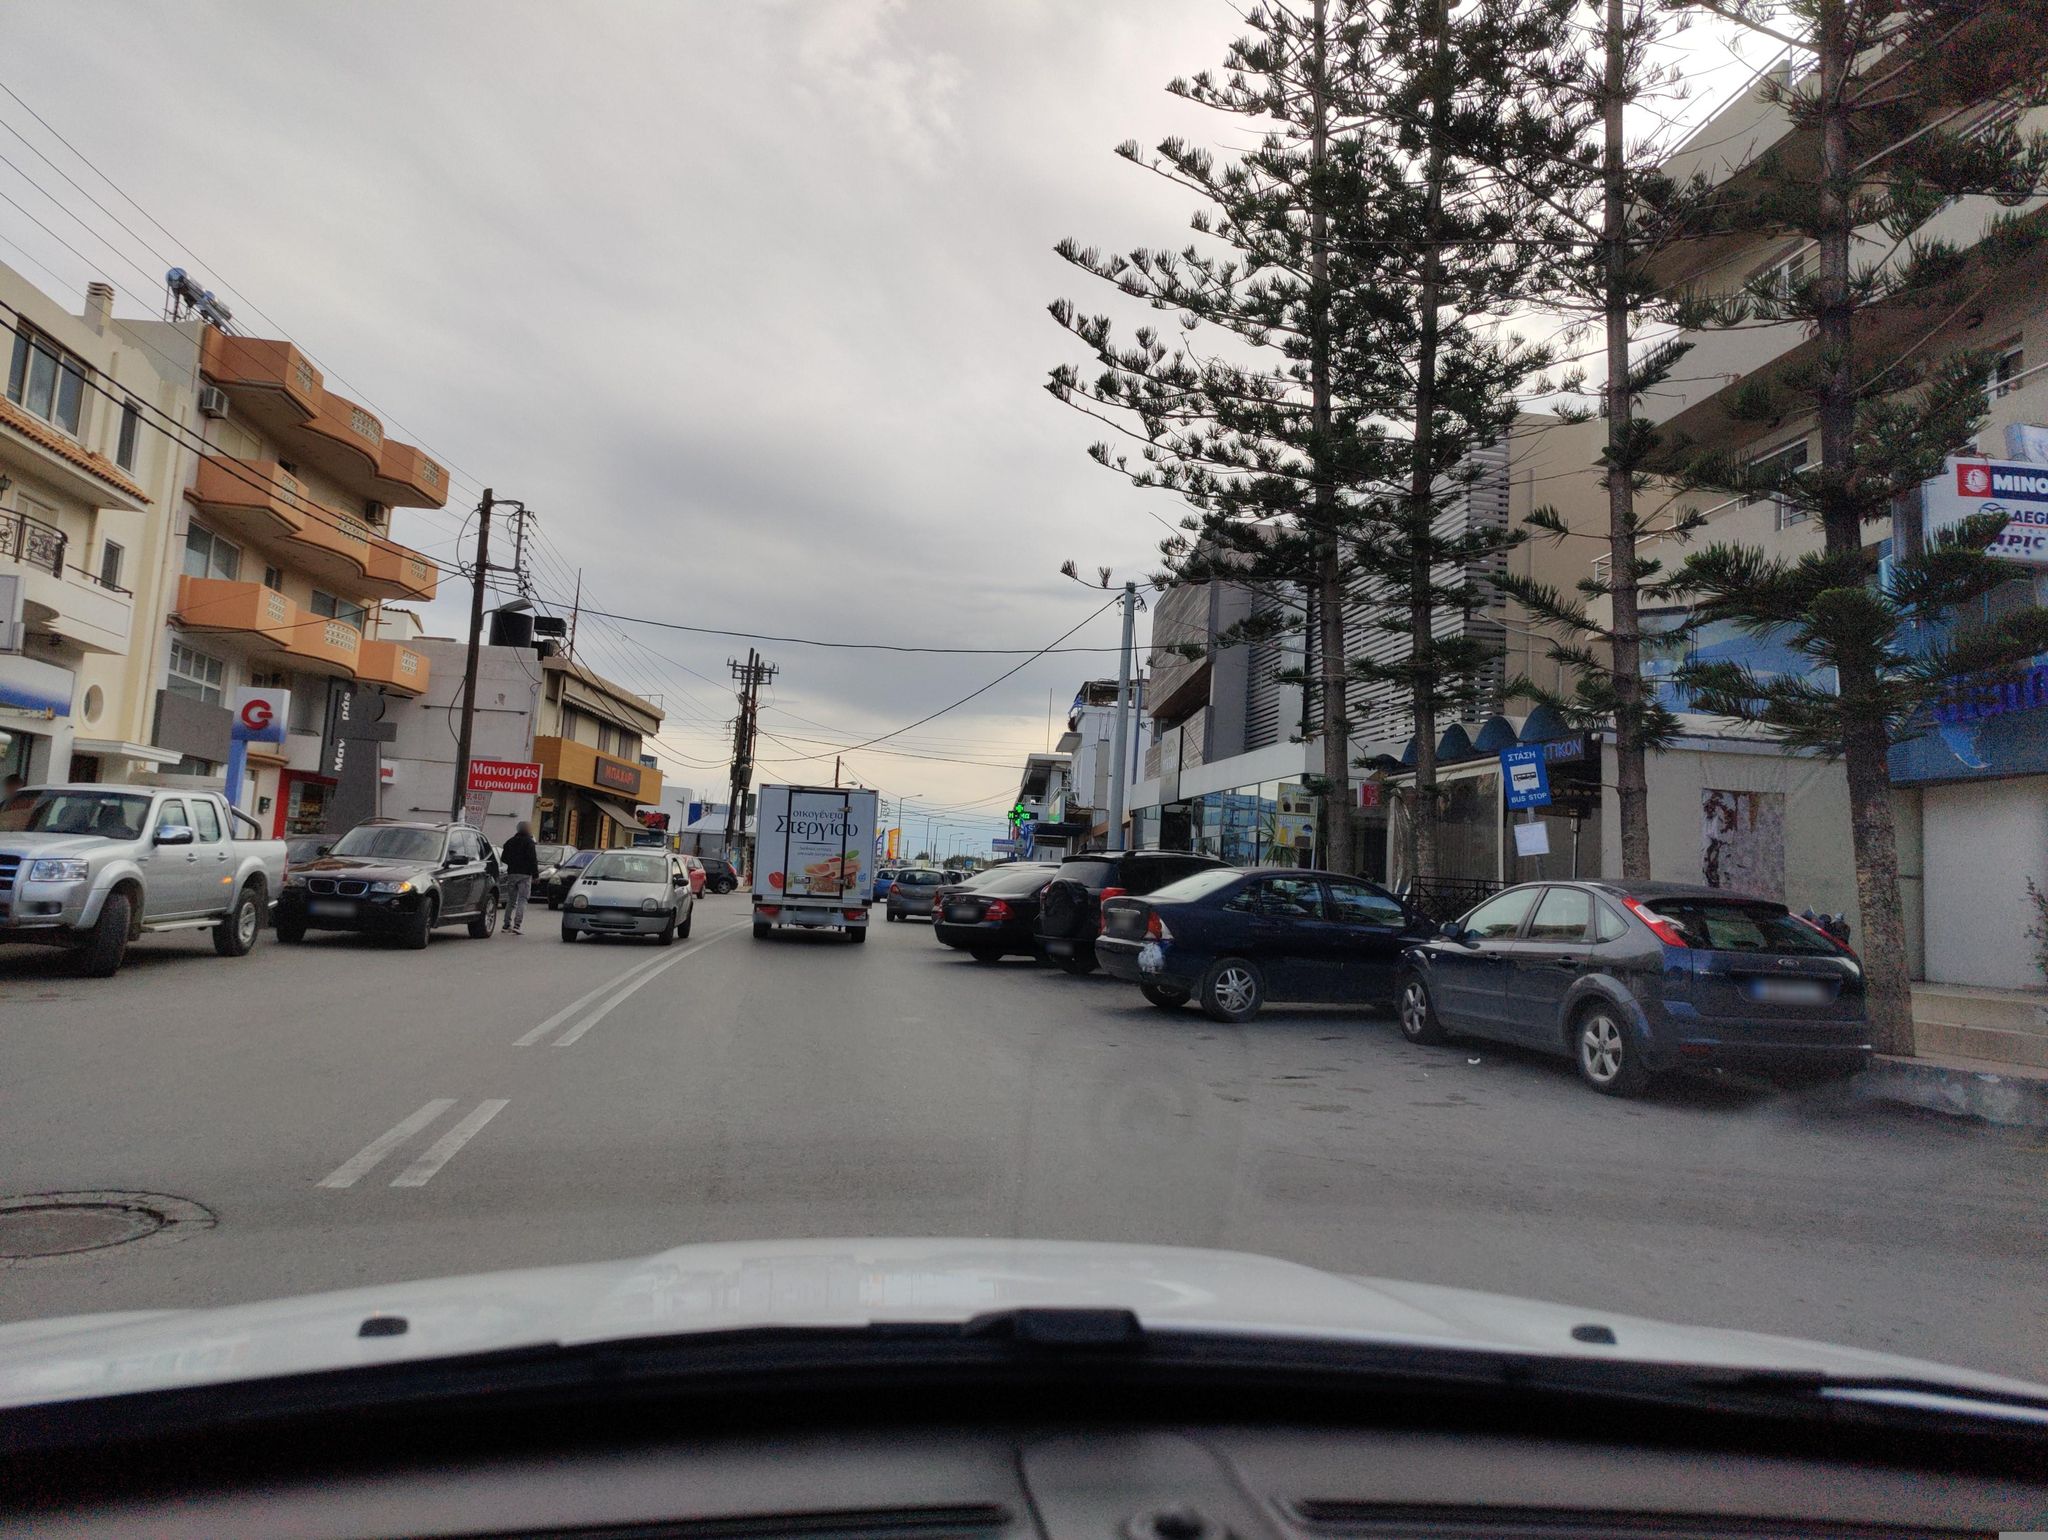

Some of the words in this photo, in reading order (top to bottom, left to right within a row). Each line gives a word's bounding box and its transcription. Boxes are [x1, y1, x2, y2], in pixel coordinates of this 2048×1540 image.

[2012, 509, 2048, 526] AEG
[471, 761, 539, 780] Μανουράς
[474, 779, 534, 792] τυροκομικά
[1511, 796, 1527, 804] BUS
[1528, 792, 1548, 801] STOP
[792, 809, 844, 821] οικογένεια
[775, 815, 859, 841] Στεργίου
